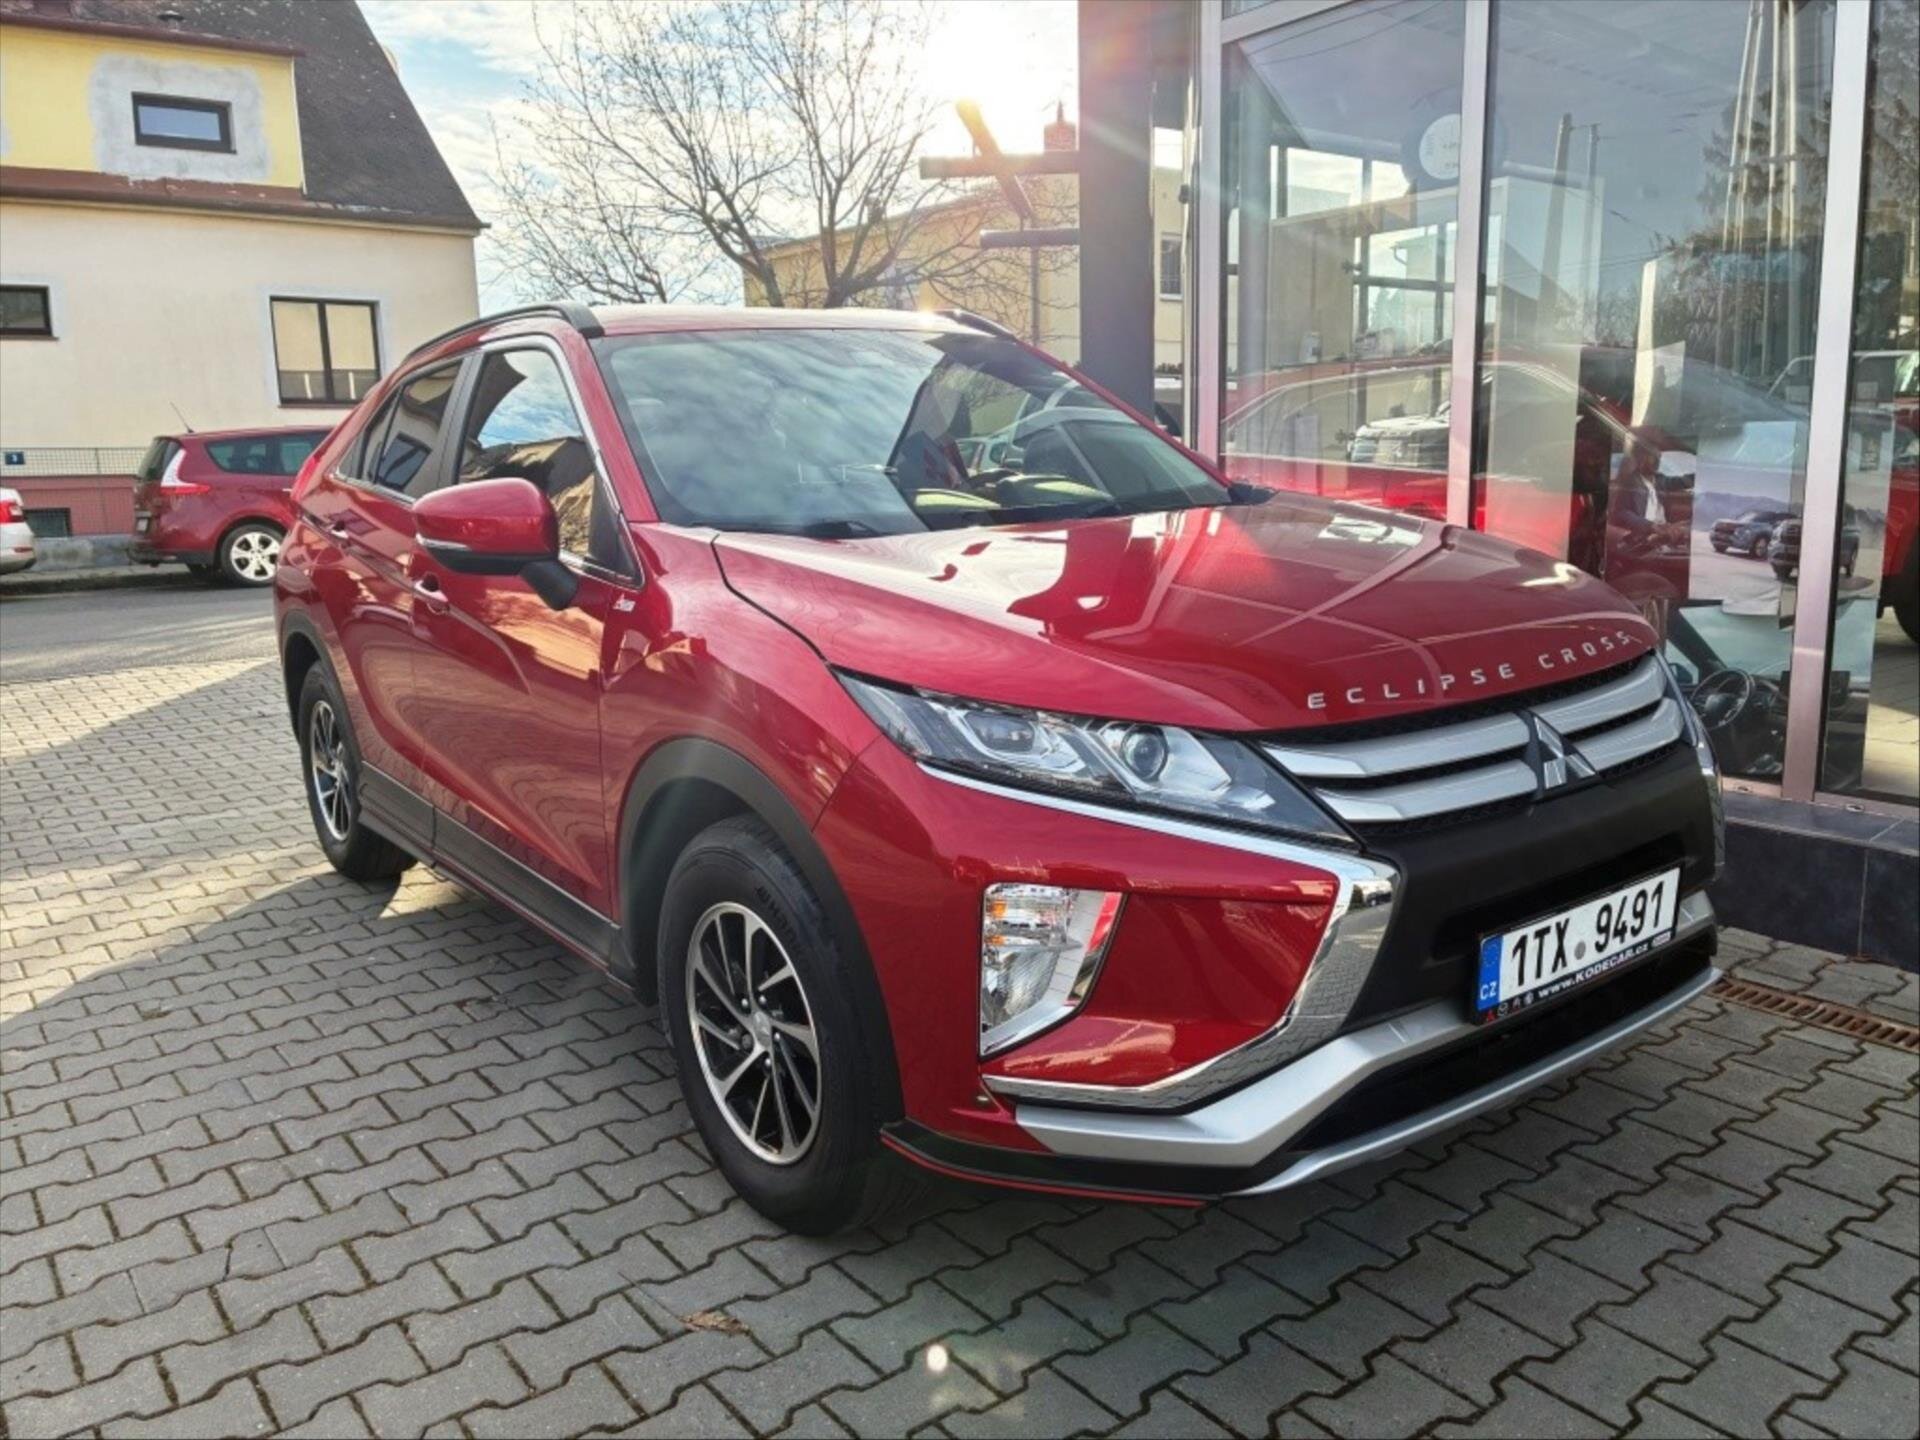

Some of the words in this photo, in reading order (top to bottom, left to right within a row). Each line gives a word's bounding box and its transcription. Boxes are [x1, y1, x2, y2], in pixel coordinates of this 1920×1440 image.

[1307, 662, 1515, 710] ECLIPSE
[1538, 630, 1631, 669] CROSS
[1512, 918, 1569, 986] 1TX
[1594, 881, 1664, 953] 9491
[1480, 981, 1498, 1001] CZ
